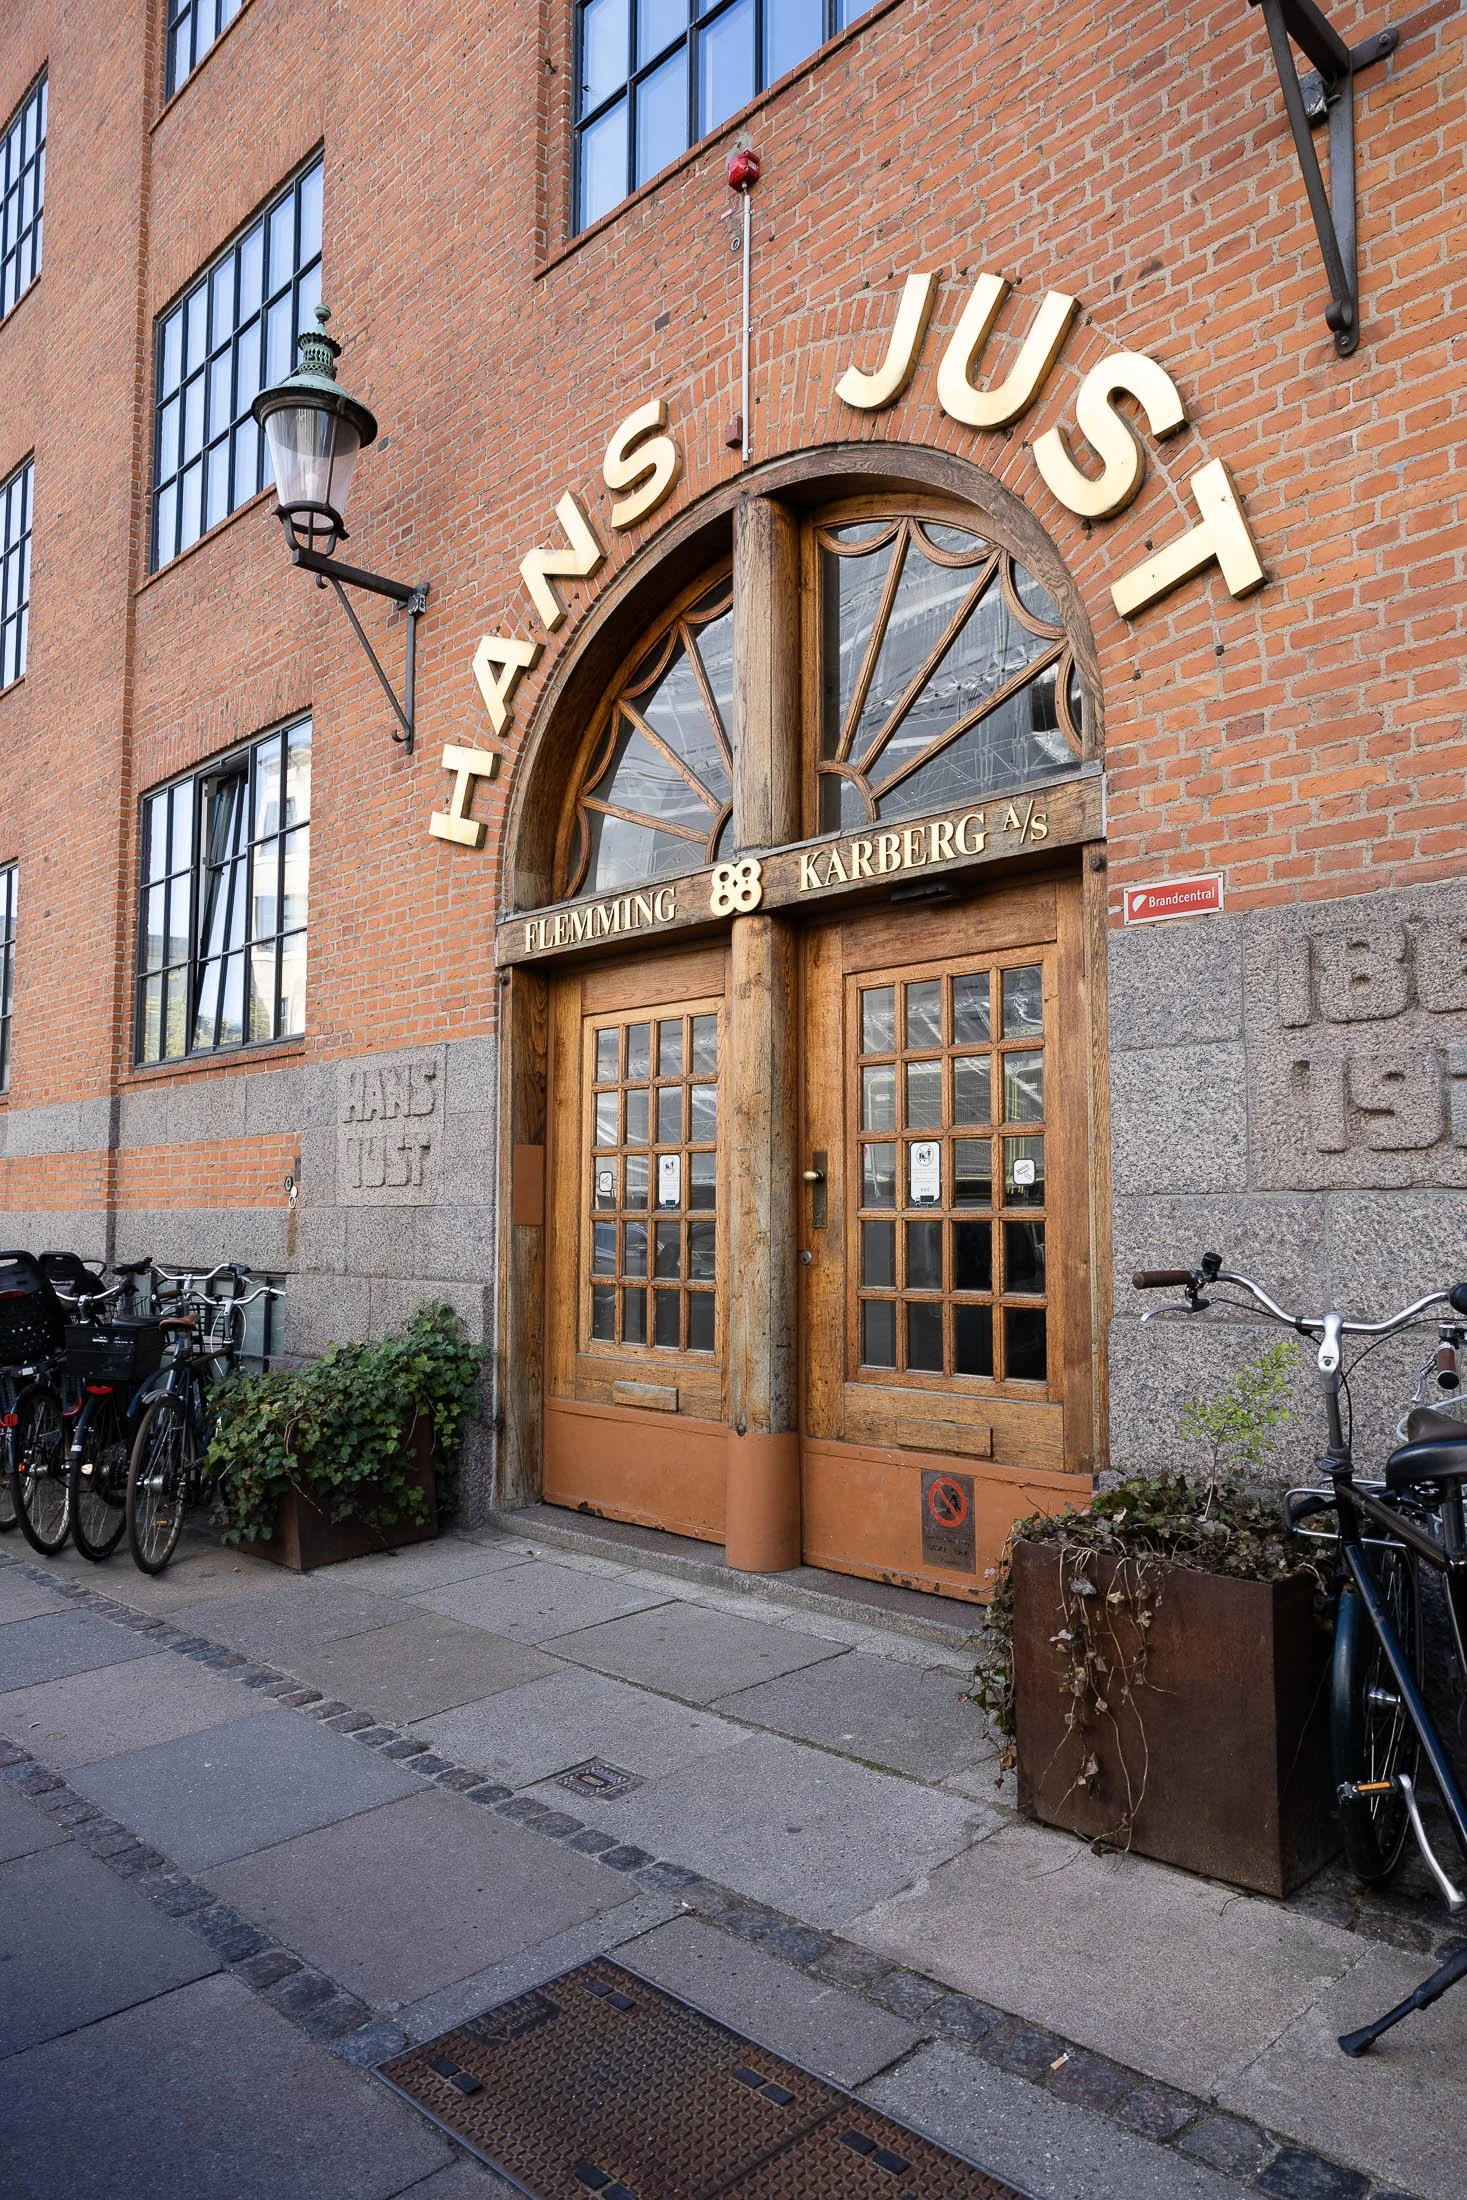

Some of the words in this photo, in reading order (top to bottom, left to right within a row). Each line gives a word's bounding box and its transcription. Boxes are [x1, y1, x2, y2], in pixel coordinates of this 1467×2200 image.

[429, 399, 683, 849] HANS
[834, 272, 1269, 619] JUST
[524, 886, 677, 954] FLEMMING
[799, 812, 989, 892] KARBERG
[1002, 799, 1049, 844] A/S
[710, 858, 762, 917] 88
[1148, 887, 1216, 909] Brandcentral
[341, 1059, 437, 1124] HANS
[1288, 1045, 1467, 1153] 19
